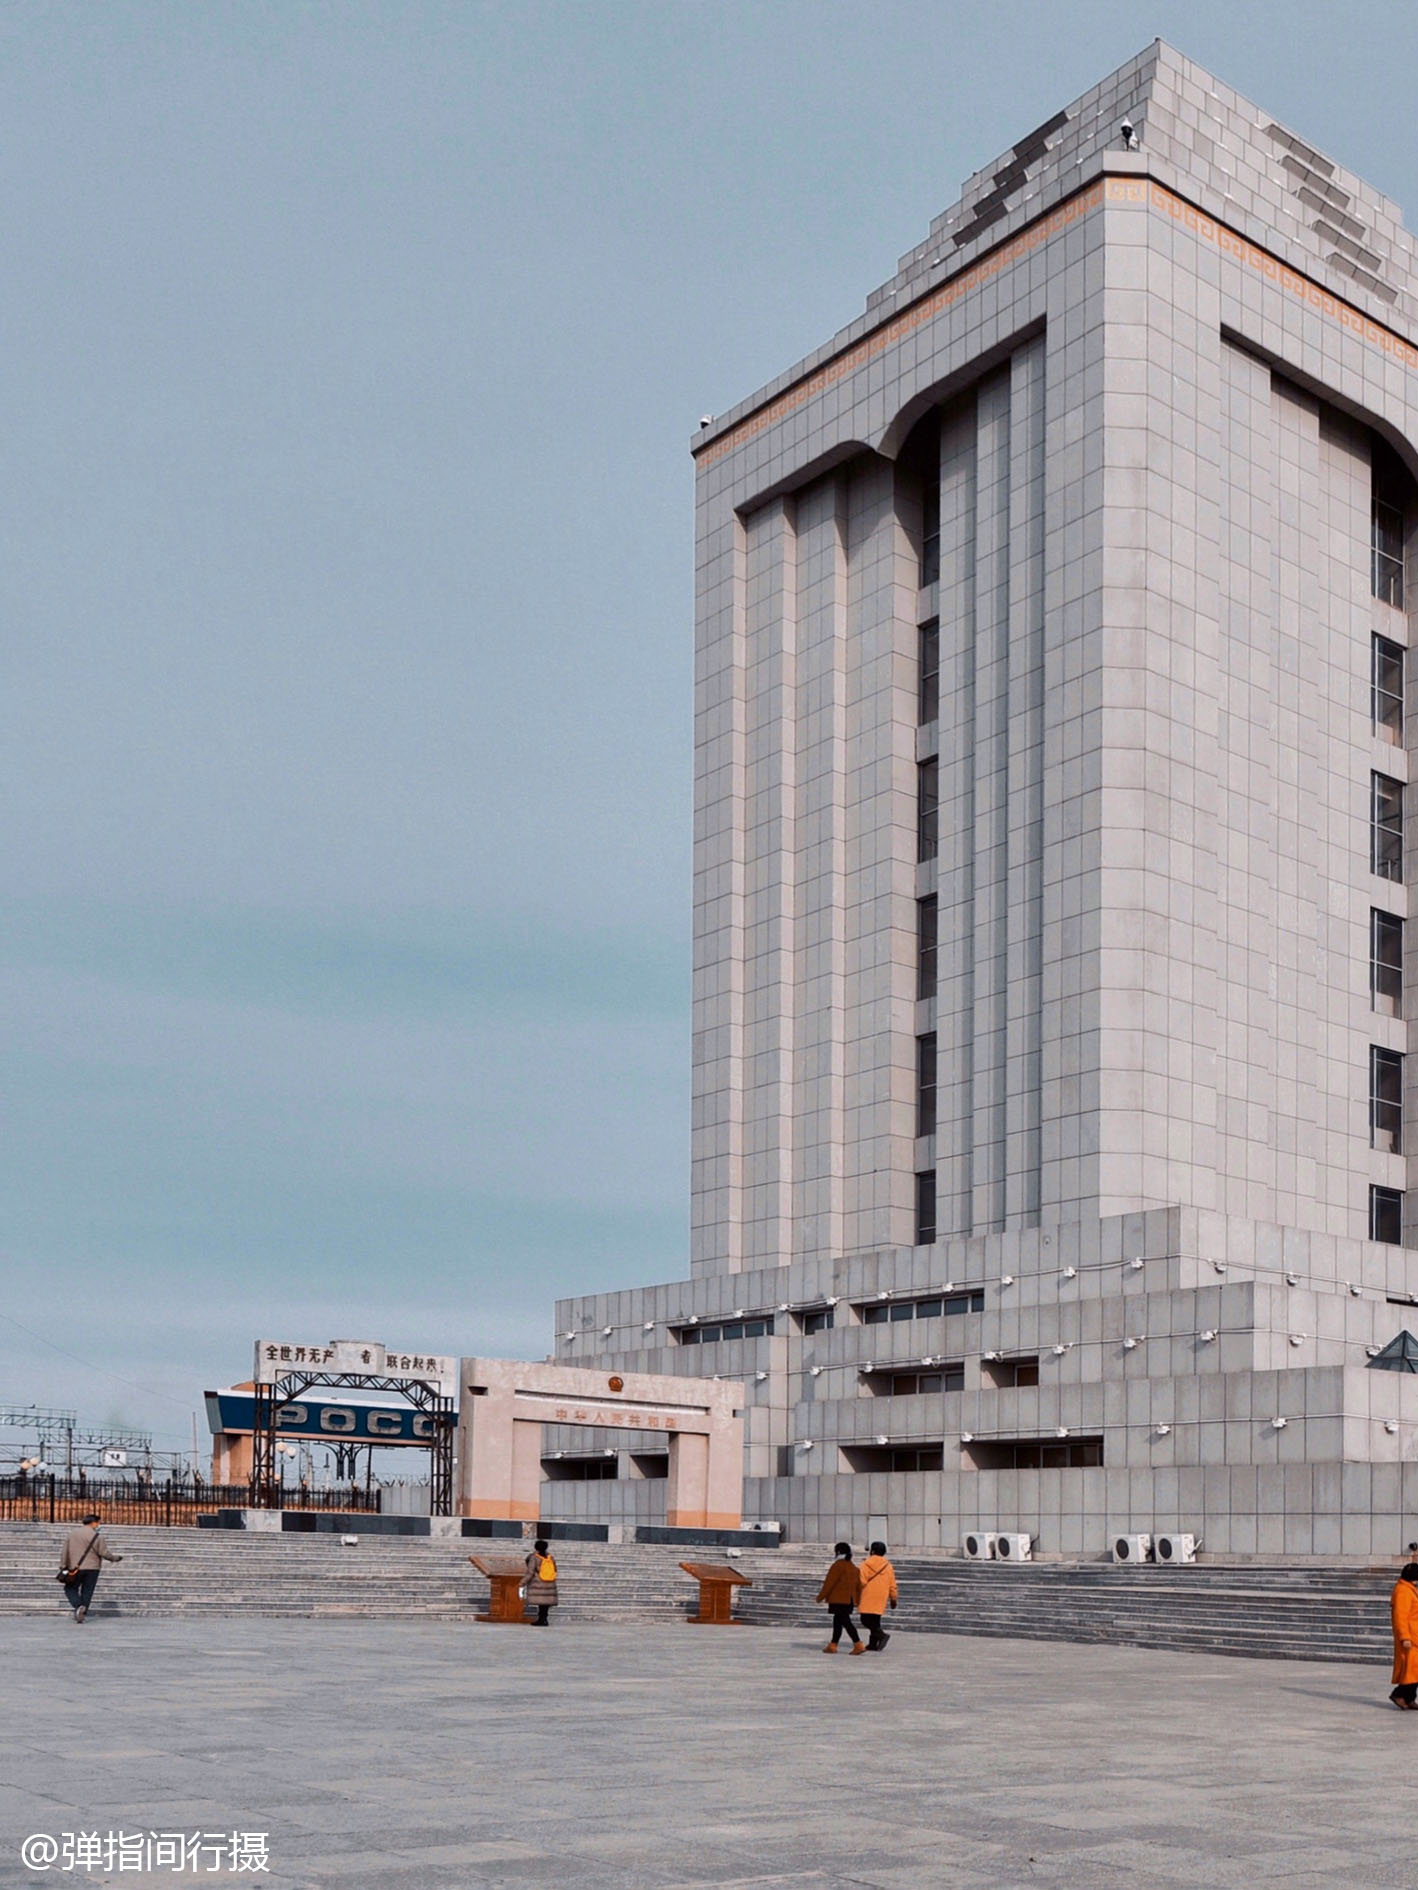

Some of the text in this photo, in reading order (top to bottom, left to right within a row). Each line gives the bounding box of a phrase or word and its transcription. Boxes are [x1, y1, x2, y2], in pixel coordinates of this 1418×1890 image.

[555, 1407, 678, 1430] 中华人民共和国
